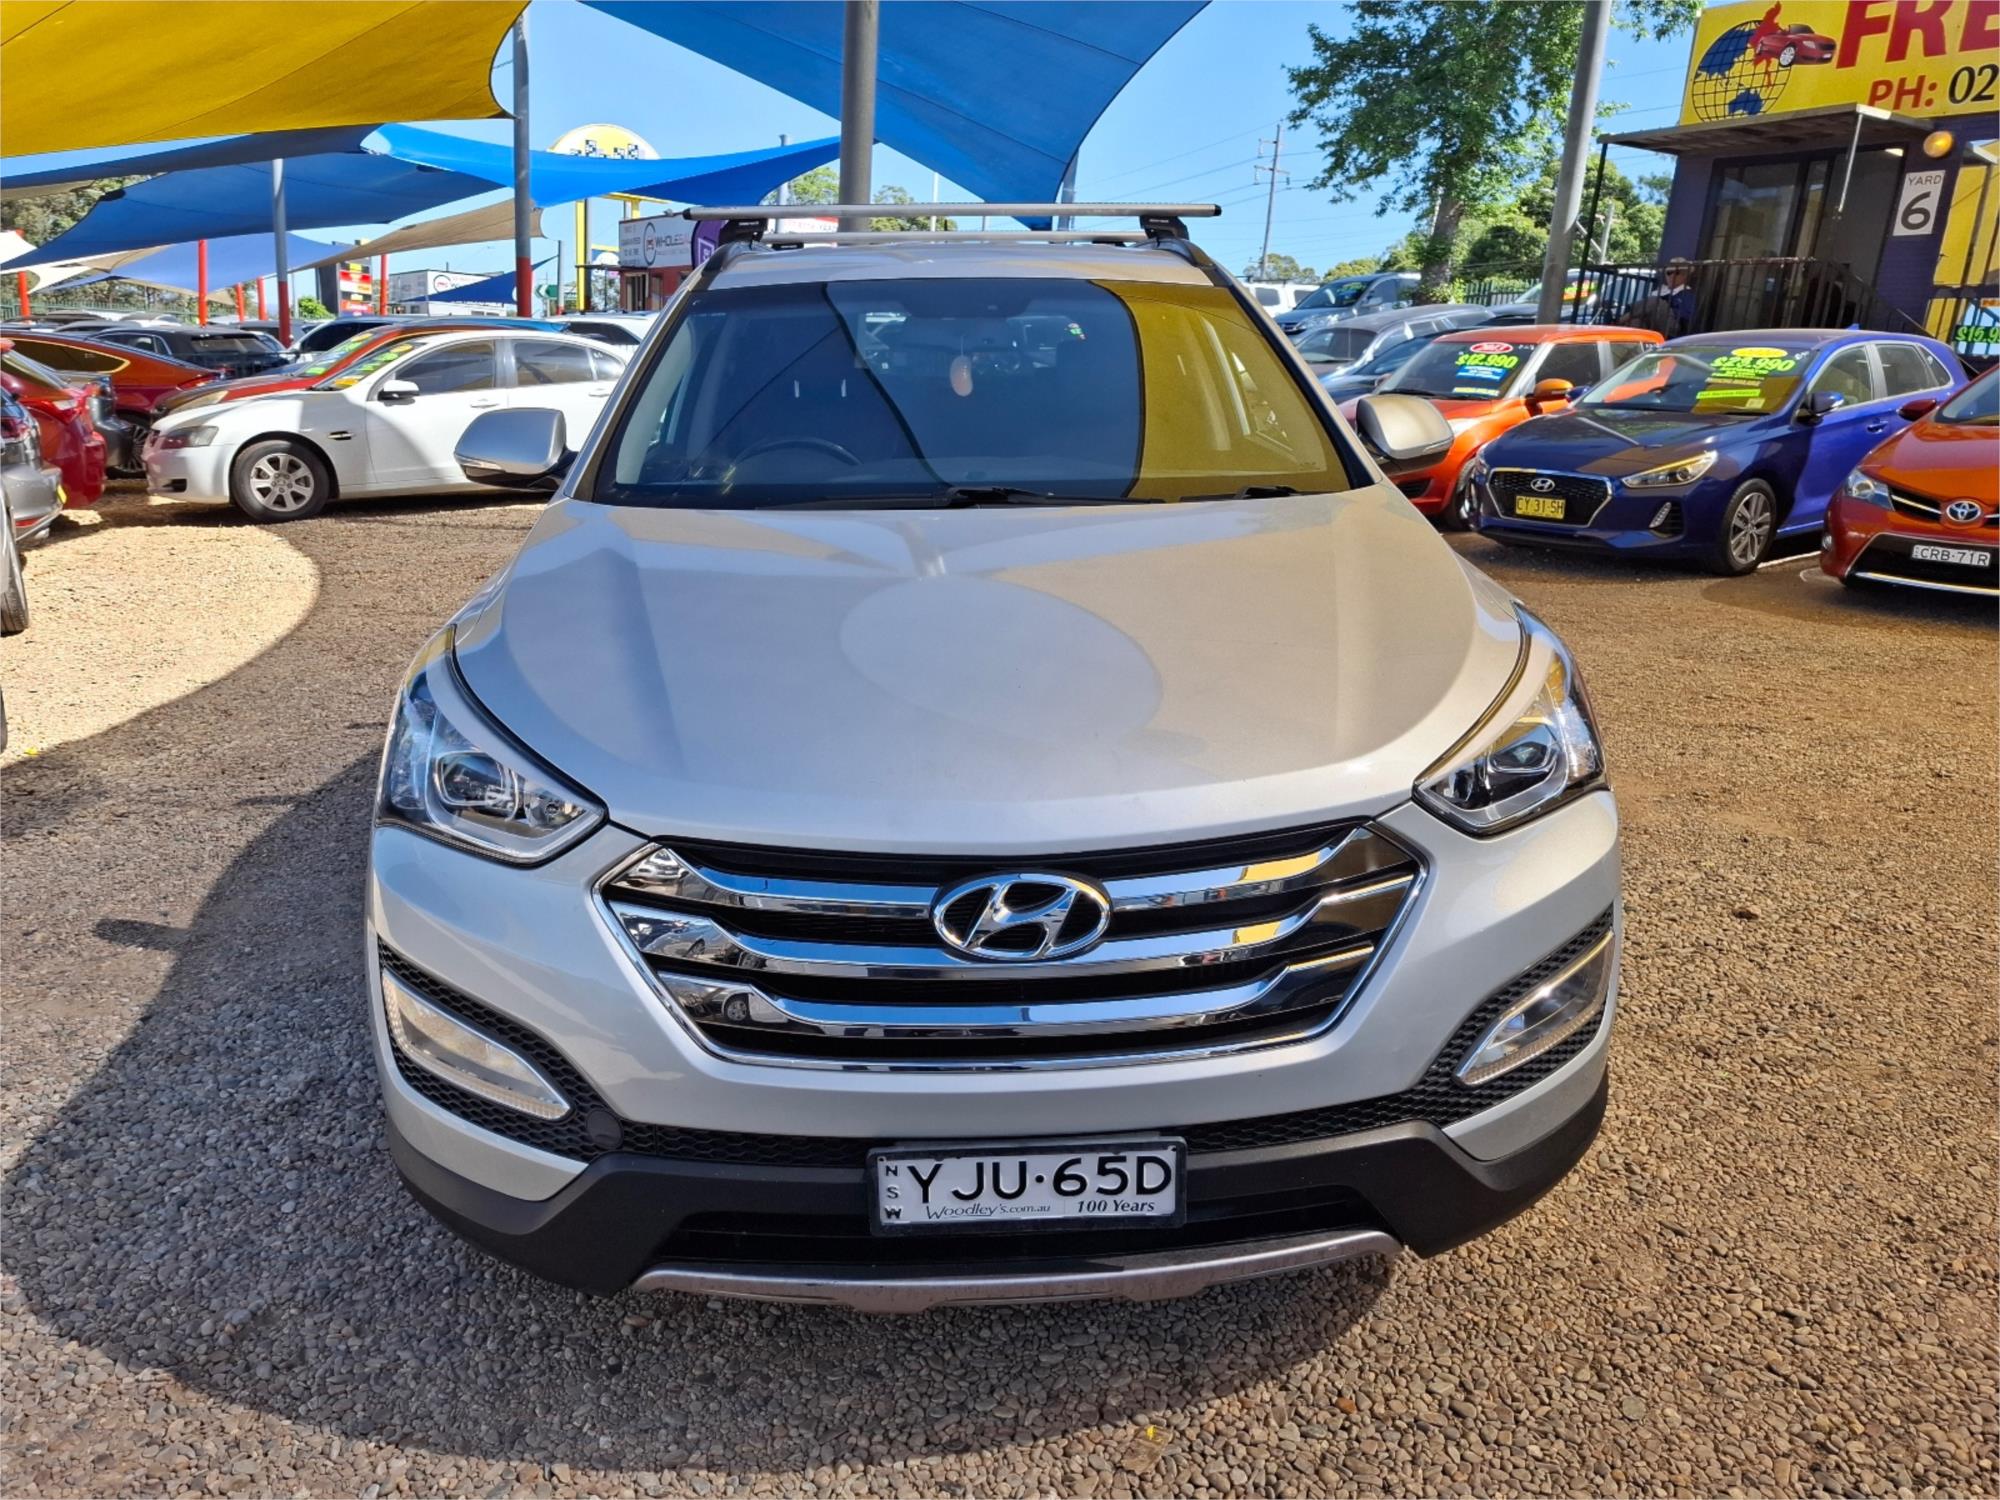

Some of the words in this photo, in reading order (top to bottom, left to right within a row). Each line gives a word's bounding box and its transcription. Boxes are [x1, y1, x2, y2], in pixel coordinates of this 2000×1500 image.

[1868, 75, 1938, 111] PH:
[1948, 63, 1999, 104] 02
[1908, 174, 1942, 186] YARD
[1901, 190, 1932, 231] 6
[1078, 1200, 1107, 1213] 100
[1112, 1199, 1155, 1213] Years
